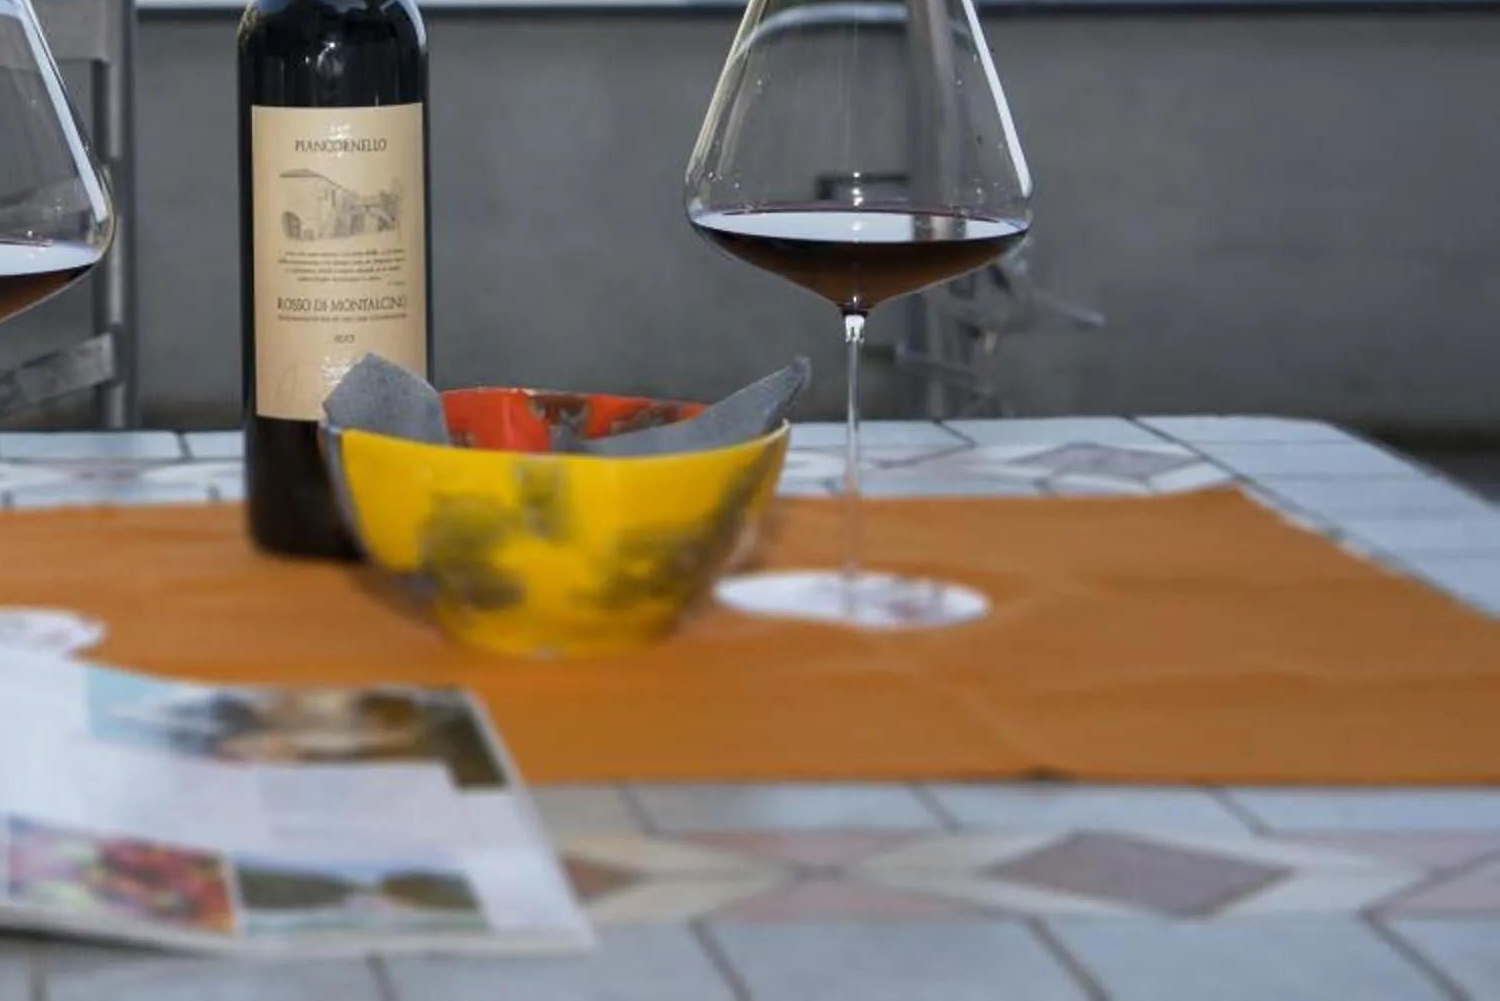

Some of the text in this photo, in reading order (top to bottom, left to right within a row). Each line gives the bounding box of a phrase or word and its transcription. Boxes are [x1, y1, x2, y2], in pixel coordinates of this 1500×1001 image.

[294, 138, 387, 152] PIANCORNELLO
[277, 295, 407, 313] ROSSO DI MONTALCINO
